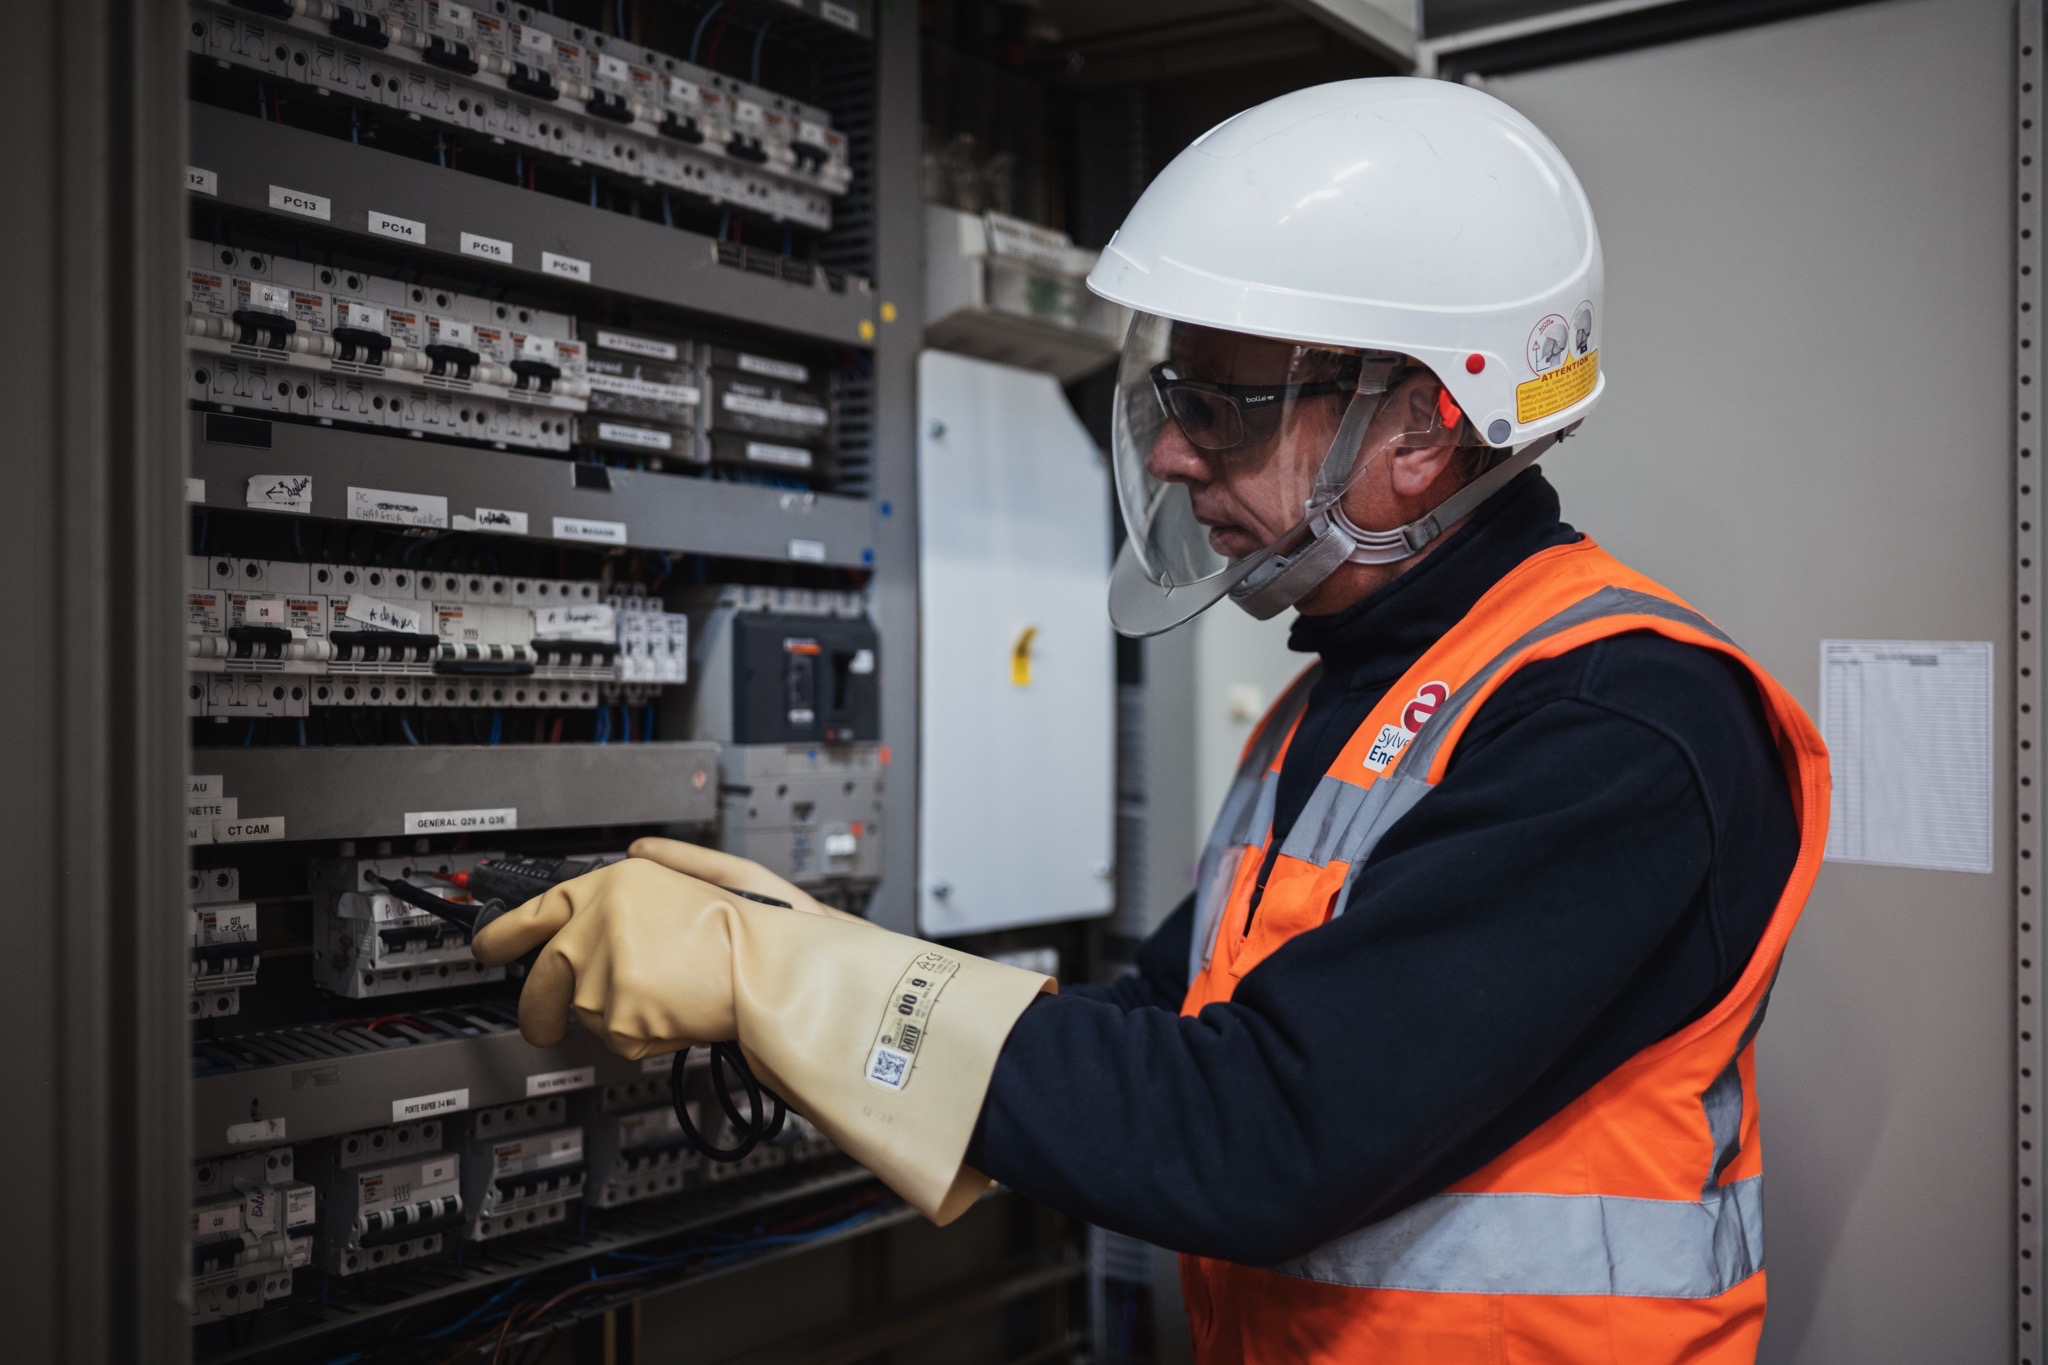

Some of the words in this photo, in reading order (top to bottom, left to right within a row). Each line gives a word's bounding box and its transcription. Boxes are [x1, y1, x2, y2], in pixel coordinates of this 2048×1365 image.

[284, 196, 316, 211] PC13
[382, 221, 412, 235] PC14
[472, 241, 501, 255] PC15
[553, 260, 580, 274] PC16
[1541, 355, 1589, 382] ATTENTION
[228, 826, 242, 836] CT
[245, 824, 270, 835] CAM
[417, 818, 457, 828] GENERAL
[460, 818, 476, 826] Q29
[912, 978, 927, 987] 9
[898, 994, 917, 1016] 00
[900, 1025, 919, 1053] CATU
[405, 1104, 420, 1114] PORTE
[421, 1101, 437, 1111] RAPIDE
